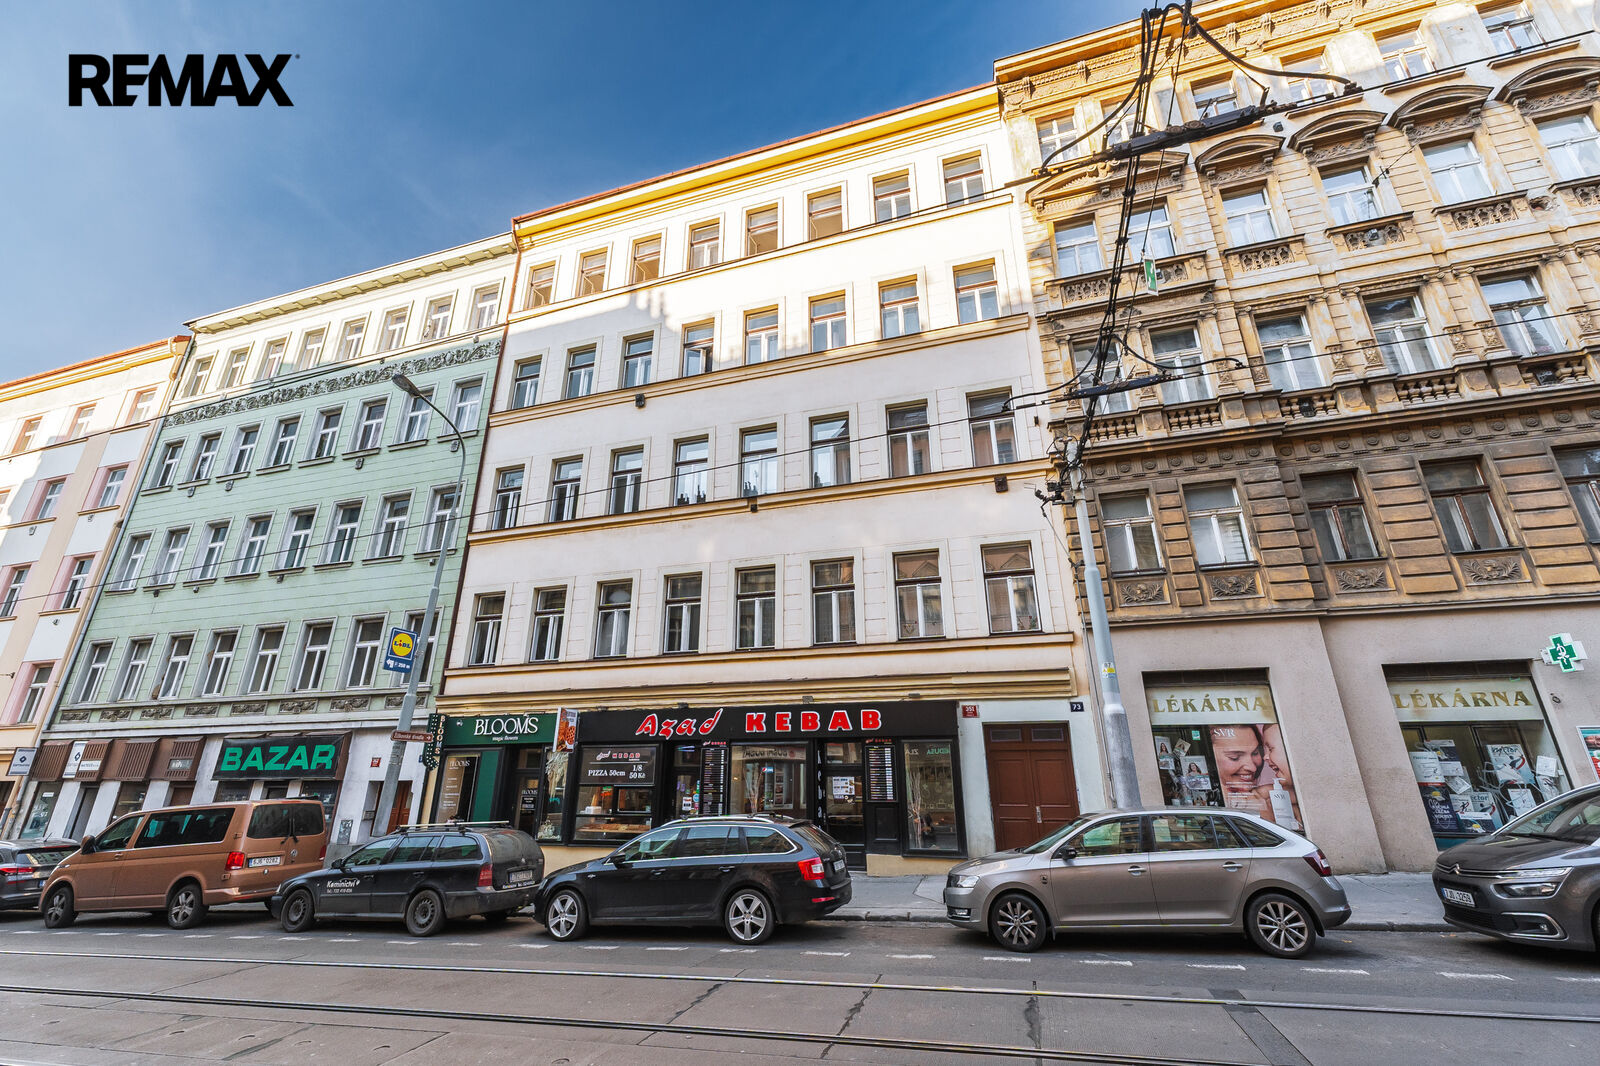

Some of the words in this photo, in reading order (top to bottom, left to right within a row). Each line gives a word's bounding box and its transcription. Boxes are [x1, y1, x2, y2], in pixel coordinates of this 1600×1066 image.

[1152, 693, 1267, 712] LÉKÁRNA
[1392, 688, 1533, 708] LÉKÁRNA
[474, 716, 539, 736] BLOOMS
[635, 708, 723, 740] Azad
[745, 709, 882, 733] KEBAB
[1213, 727, 1235, 737] SVR
[435, 715, 446, 755] BLOOMS
[220, 744, 336, 771] BAZAR
[588, 769, 608, 777] PIZZA
[629, 771, 637, 779] 50
[632, 764, 643, 772] 1/8
